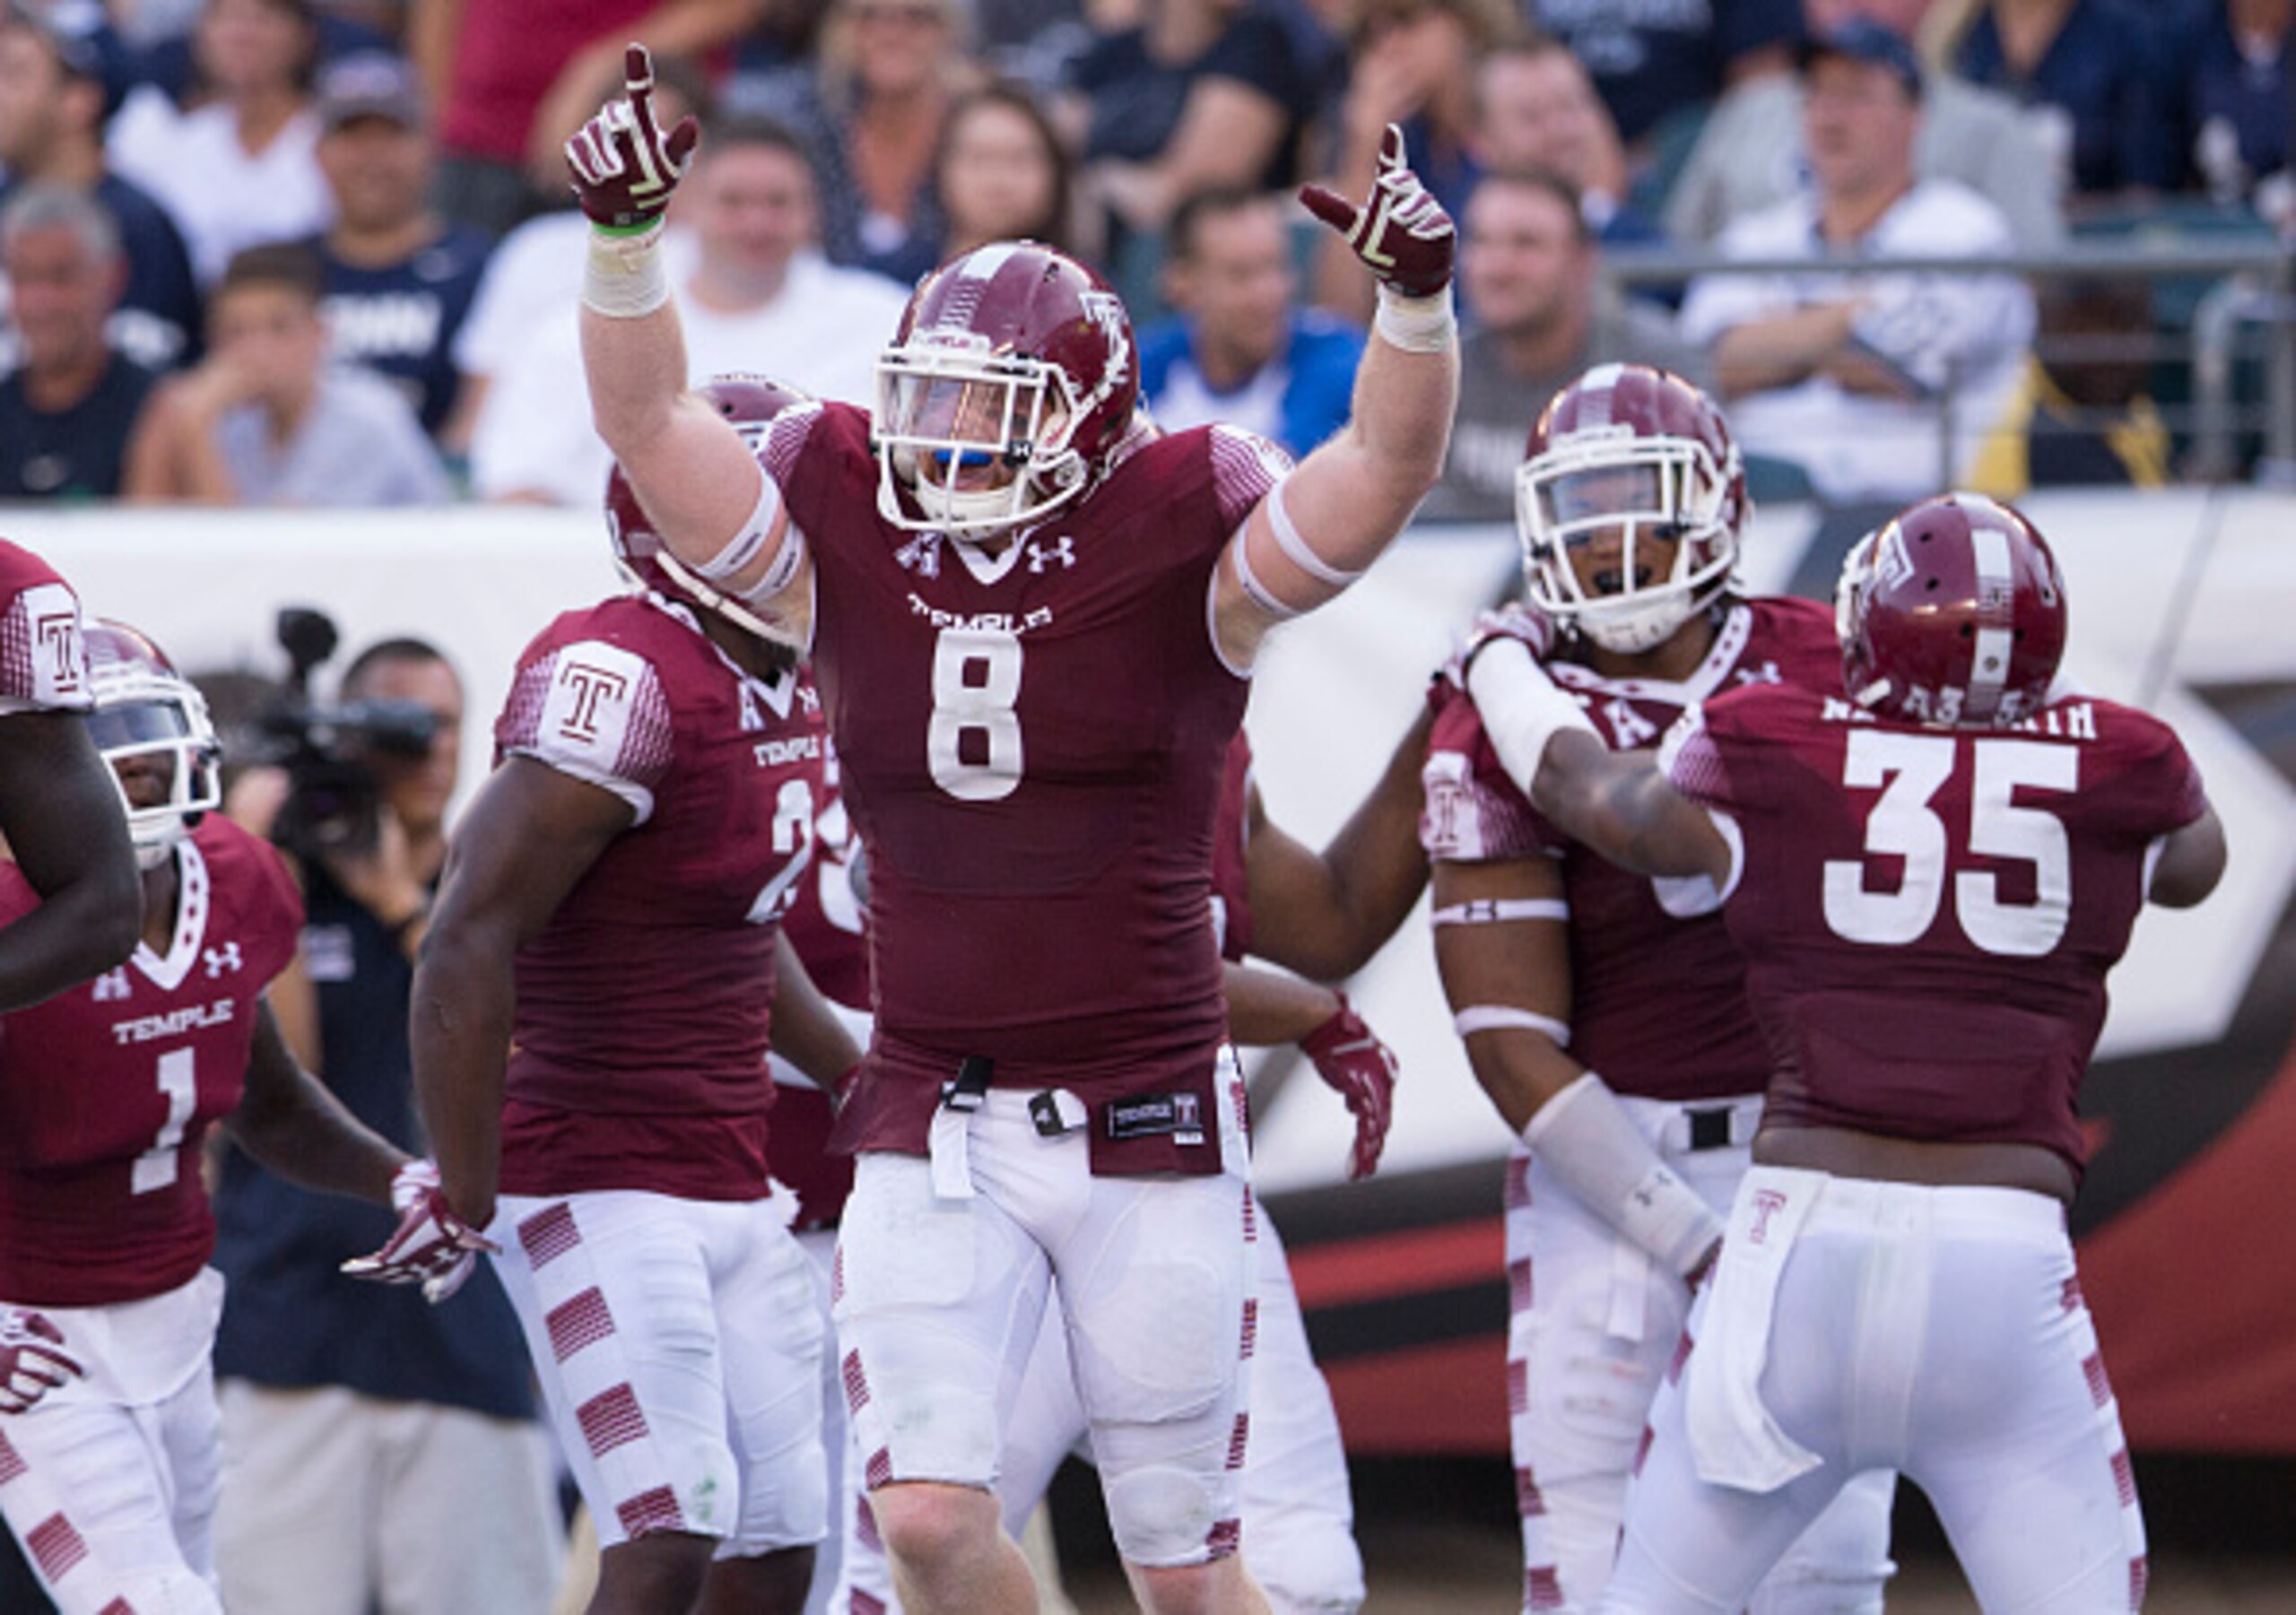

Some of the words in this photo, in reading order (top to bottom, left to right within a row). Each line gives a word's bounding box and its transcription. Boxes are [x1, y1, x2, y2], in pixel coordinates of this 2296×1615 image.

[560, 660, 628, 744] T
[927, 626, 1024, 801] 8
[744, 778, 813, 924] 2
[1823, 728, 2080, 956] 35
[112, 998, 234, 1045] TEMPLE
[131, 1046, 196, 1194] 1
